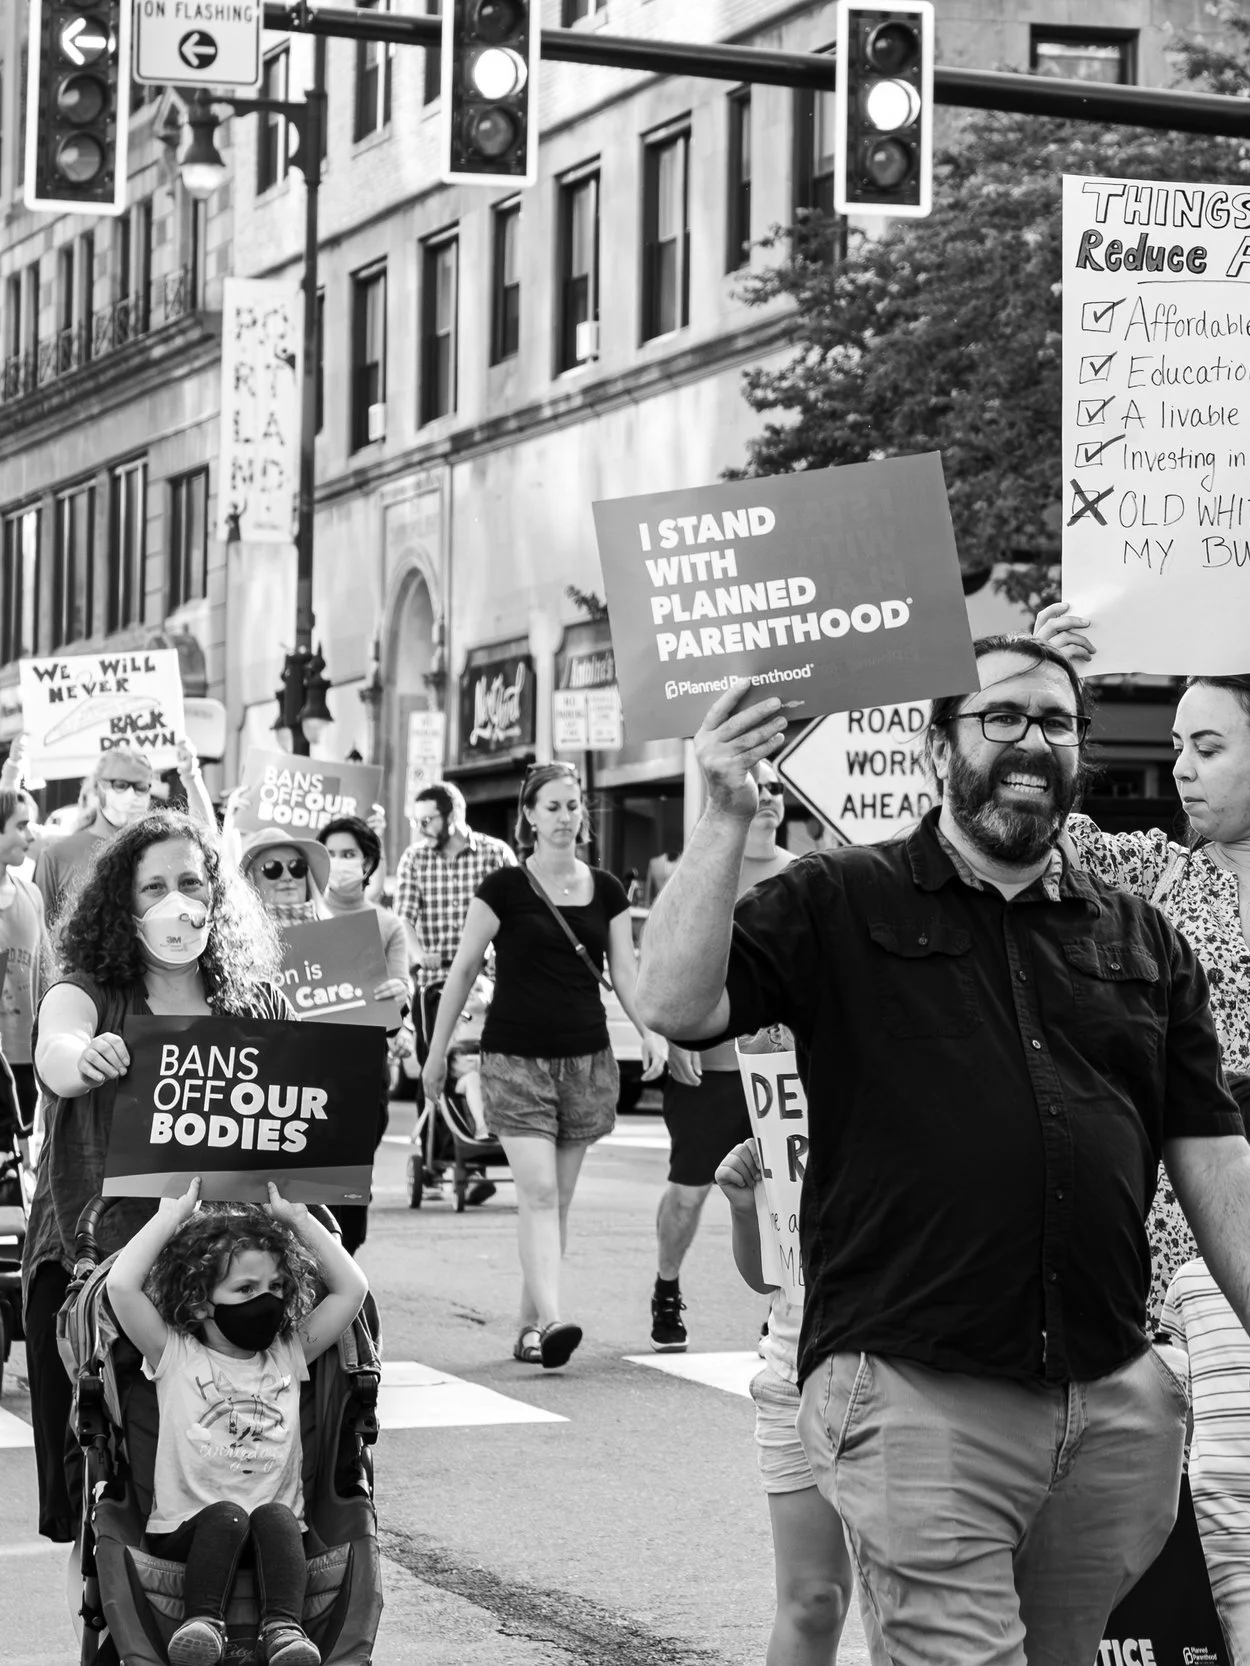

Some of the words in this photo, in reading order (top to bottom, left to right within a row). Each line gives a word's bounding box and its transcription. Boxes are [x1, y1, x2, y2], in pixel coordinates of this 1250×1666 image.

[143, 0, 165, 17] ON
[175, 1, 253, 22] FLASHING
[1076, 229, 1208, 274] Reduce
[1121, 399, 1145, 429] A
[1161, 400, 1240, 428] livable
[1123, 443, 1216, 492] Investing
[1229, 450, 1246, 466] in
[1119, 491, 1184, 529] OLD
[639, 522, 651, 551] I
[659, 506, 776, 549] STAND
[645, 548, 738, 587] WITH
[1123, 539, 1174, 575] MY
[650, 576, 816, 625] PLANNED
[655, 599, 911, 662] PARENTHOOD
[32, 663, 71, 682] WE
[679, 675, 729, 696] Planned
[49, 678, 129, 703] NEVER
[110, 709, 167, 734] BACK
[848, 708, 924, 733] ROAD
[100, 731, 176, 751] DOWN
[846, 750, 926, 776] WORK
[264, 766, 324, 793] BANS
[260, 784, 304, 807] OFF
[305, 792, 357, 816] OUR
[840, 793, 932, 819] AHEAD
[258, 801, 342, 829] BODIE
[304, 960, 323, 981] is
[295, 982, 363, 1008] Care.
[159, 1044, 259, 1080] BANS
[153, 1078, 226, 1112] OFF
[230, 1081, 328, 1120] OUR
[150, 1112, 309, 1153] BODIES
